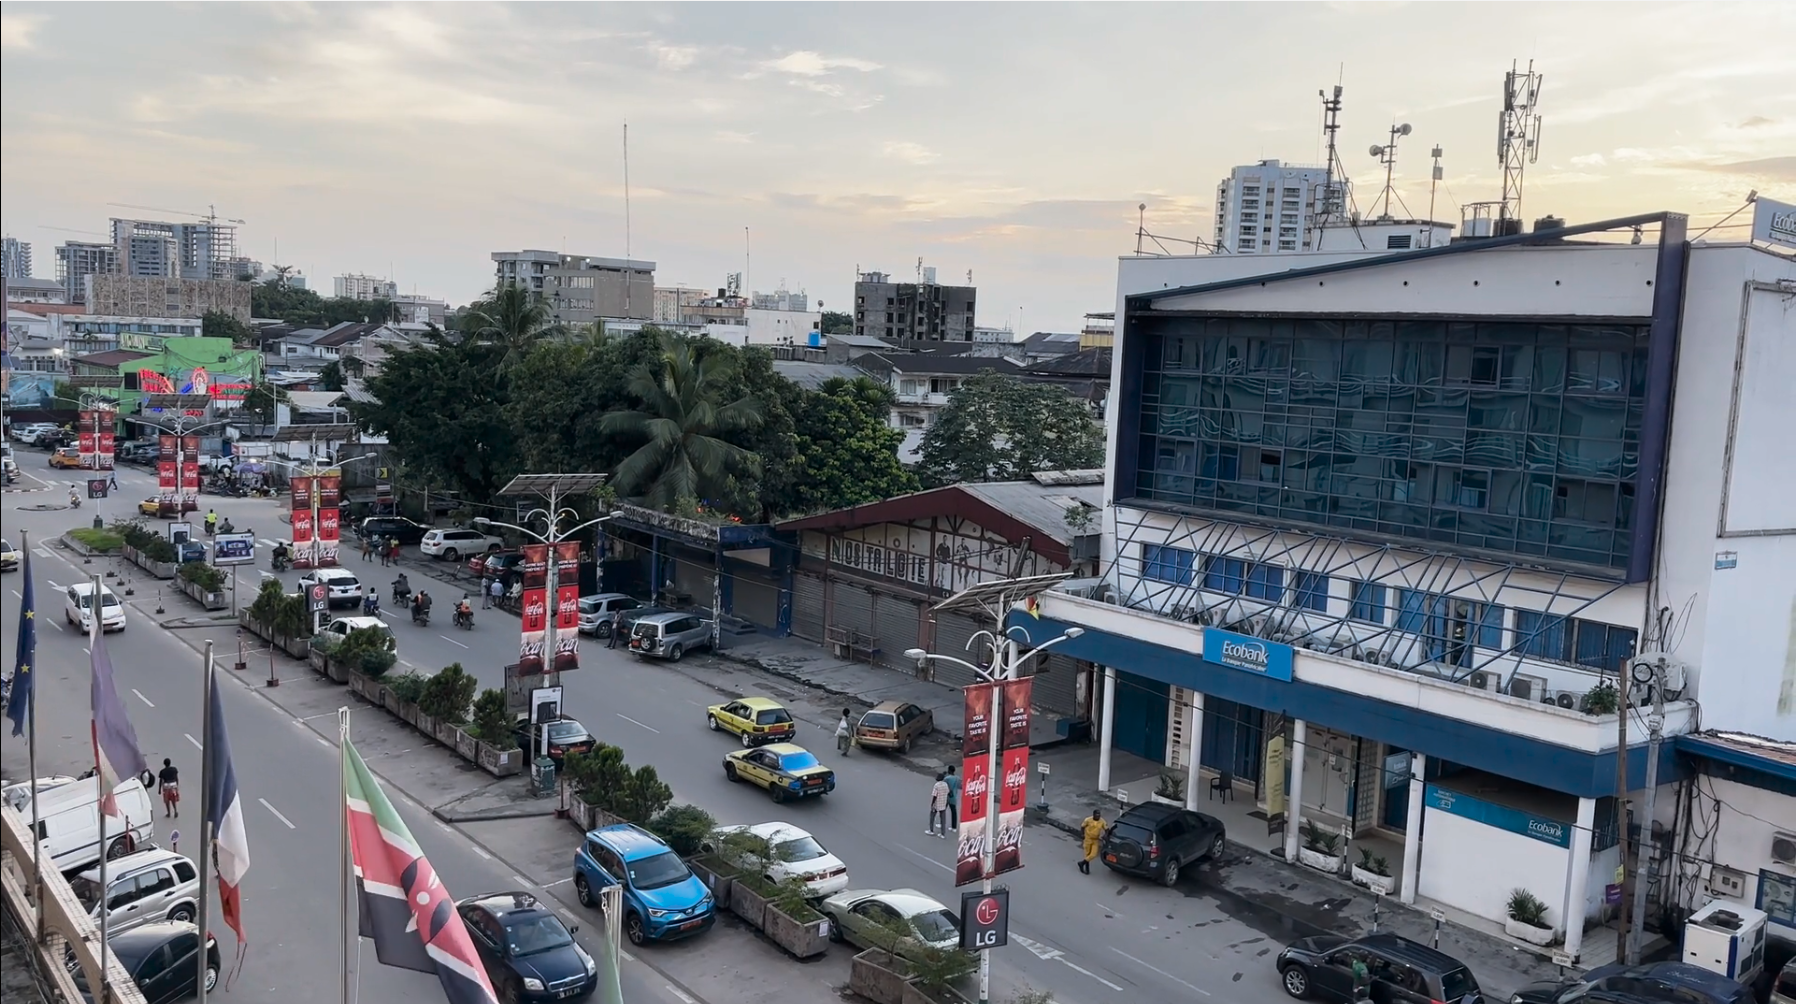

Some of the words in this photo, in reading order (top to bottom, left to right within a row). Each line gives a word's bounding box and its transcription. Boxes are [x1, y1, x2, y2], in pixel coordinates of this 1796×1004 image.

[831, 537, 926, 583] NOSTALGIE
[314, 602, 324, 610] LG
[1222, 640, 1270, 664] Ecobank
[1528, 820, 1563, 837] Ecobank
[976, 930, 996, 946] LG
